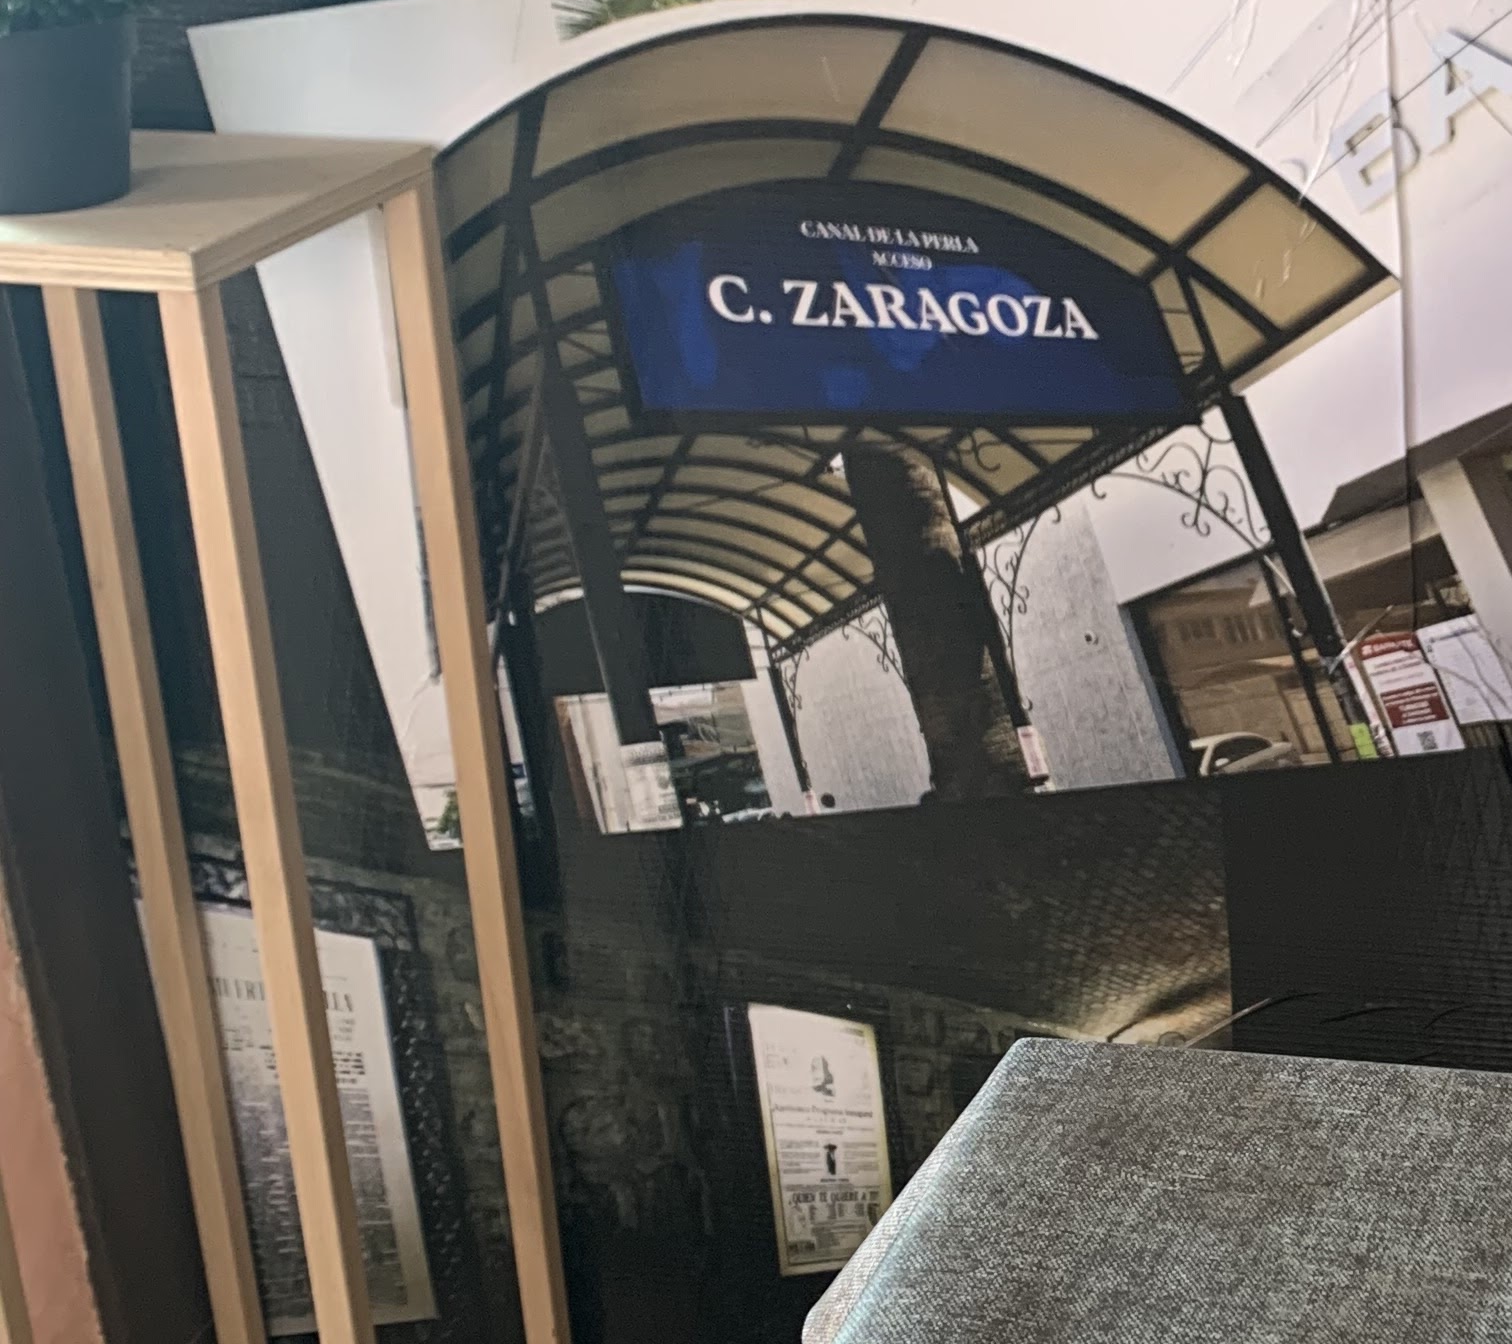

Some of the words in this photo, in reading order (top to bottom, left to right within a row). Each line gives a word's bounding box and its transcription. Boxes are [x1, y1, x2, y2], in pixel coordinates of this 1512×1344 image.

[800, 220, 866, 243] CANAL
[867, 225, 894, 245] DE
[894, 228, 920, 249] LA
[921, 231, 979, 254] PERLA
[872, 249, 933, 271] ACCESO
[708, 274, 773, 324] C.
[783, 279, 1099, 341] ZARAGOZA
